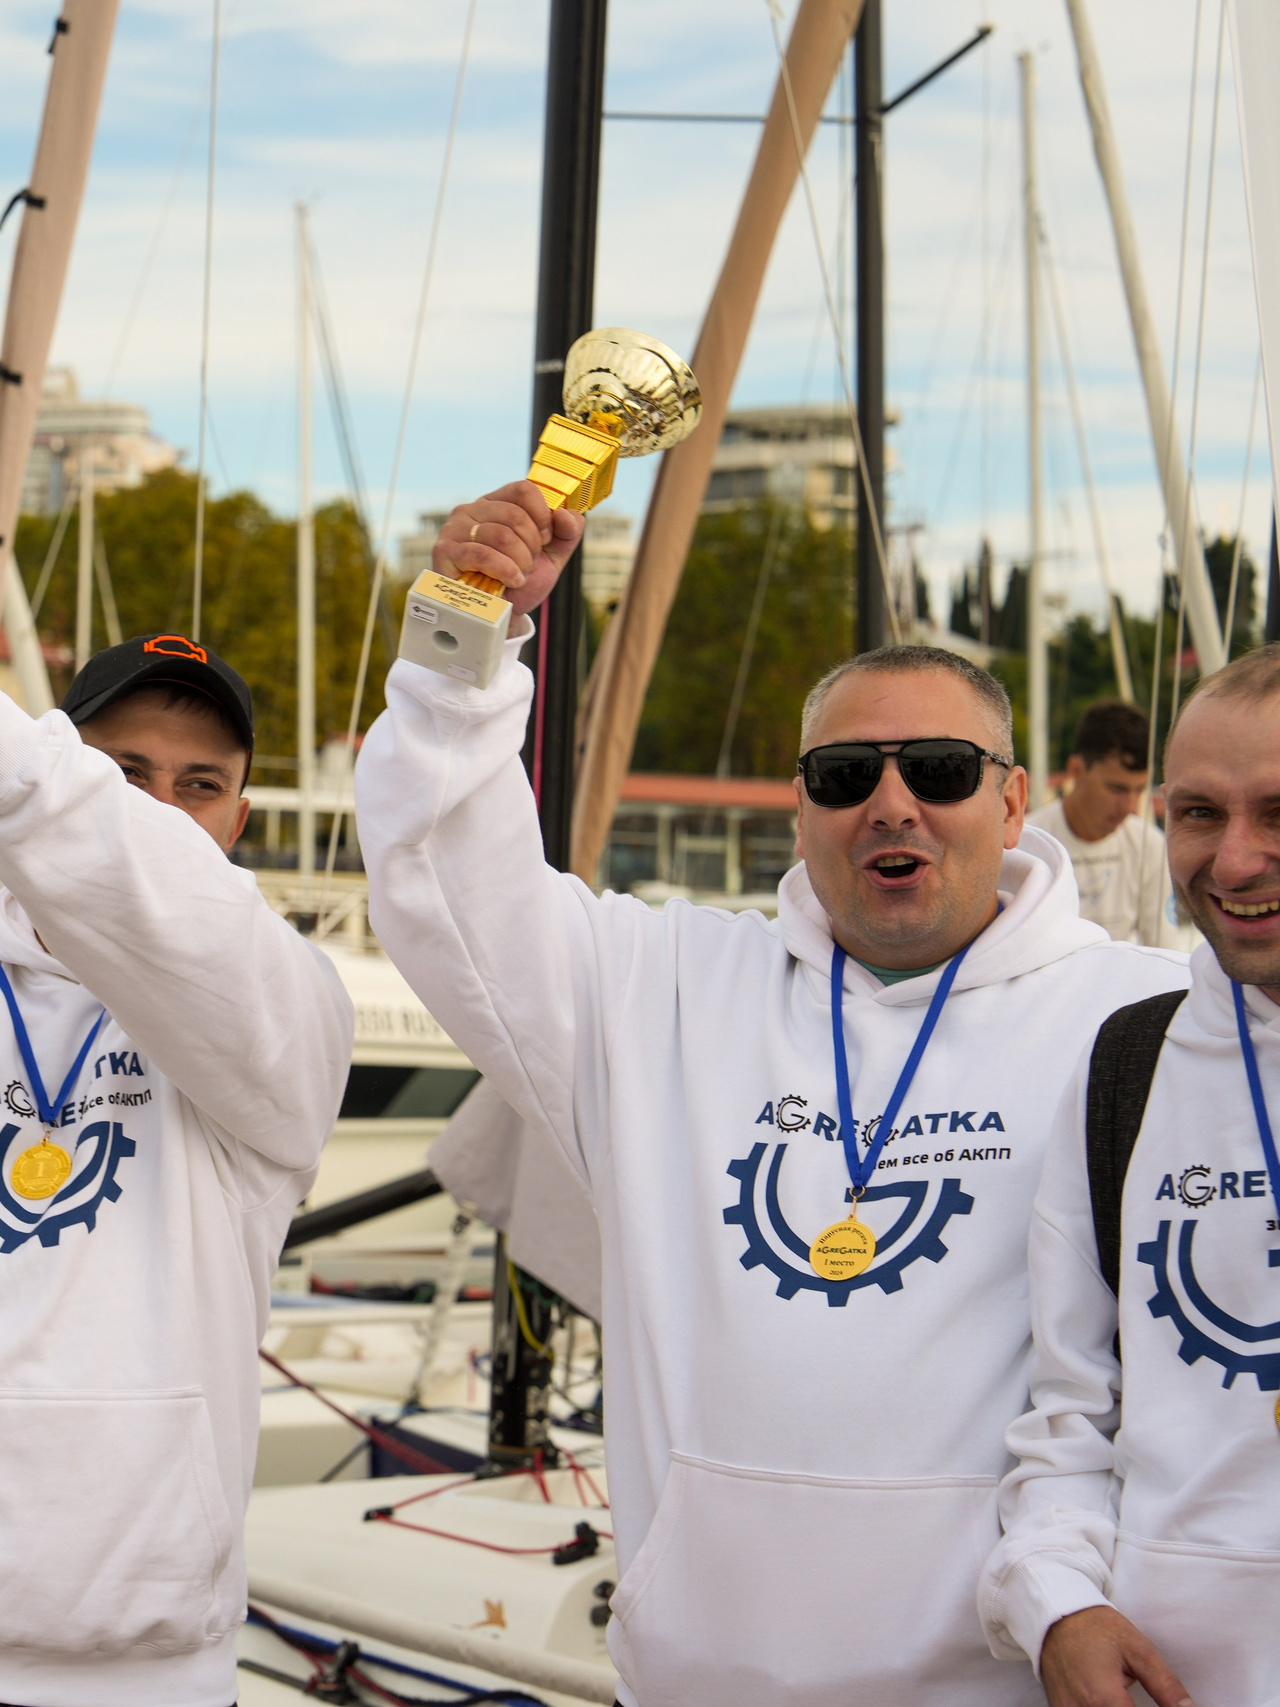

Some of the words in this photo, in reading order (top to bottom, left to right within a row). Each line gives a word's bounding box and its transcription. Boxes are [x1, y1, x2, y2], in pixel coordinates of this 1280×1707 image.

[902, 1152, 929, 1167] все
[934, 1149, 955, 1164] об
[959, 1147, 1012, 1162] АКПП
[1155, 1164, 1275, 1209] AGRE
[816, 1246, 867, 1255] AGREGATKA
